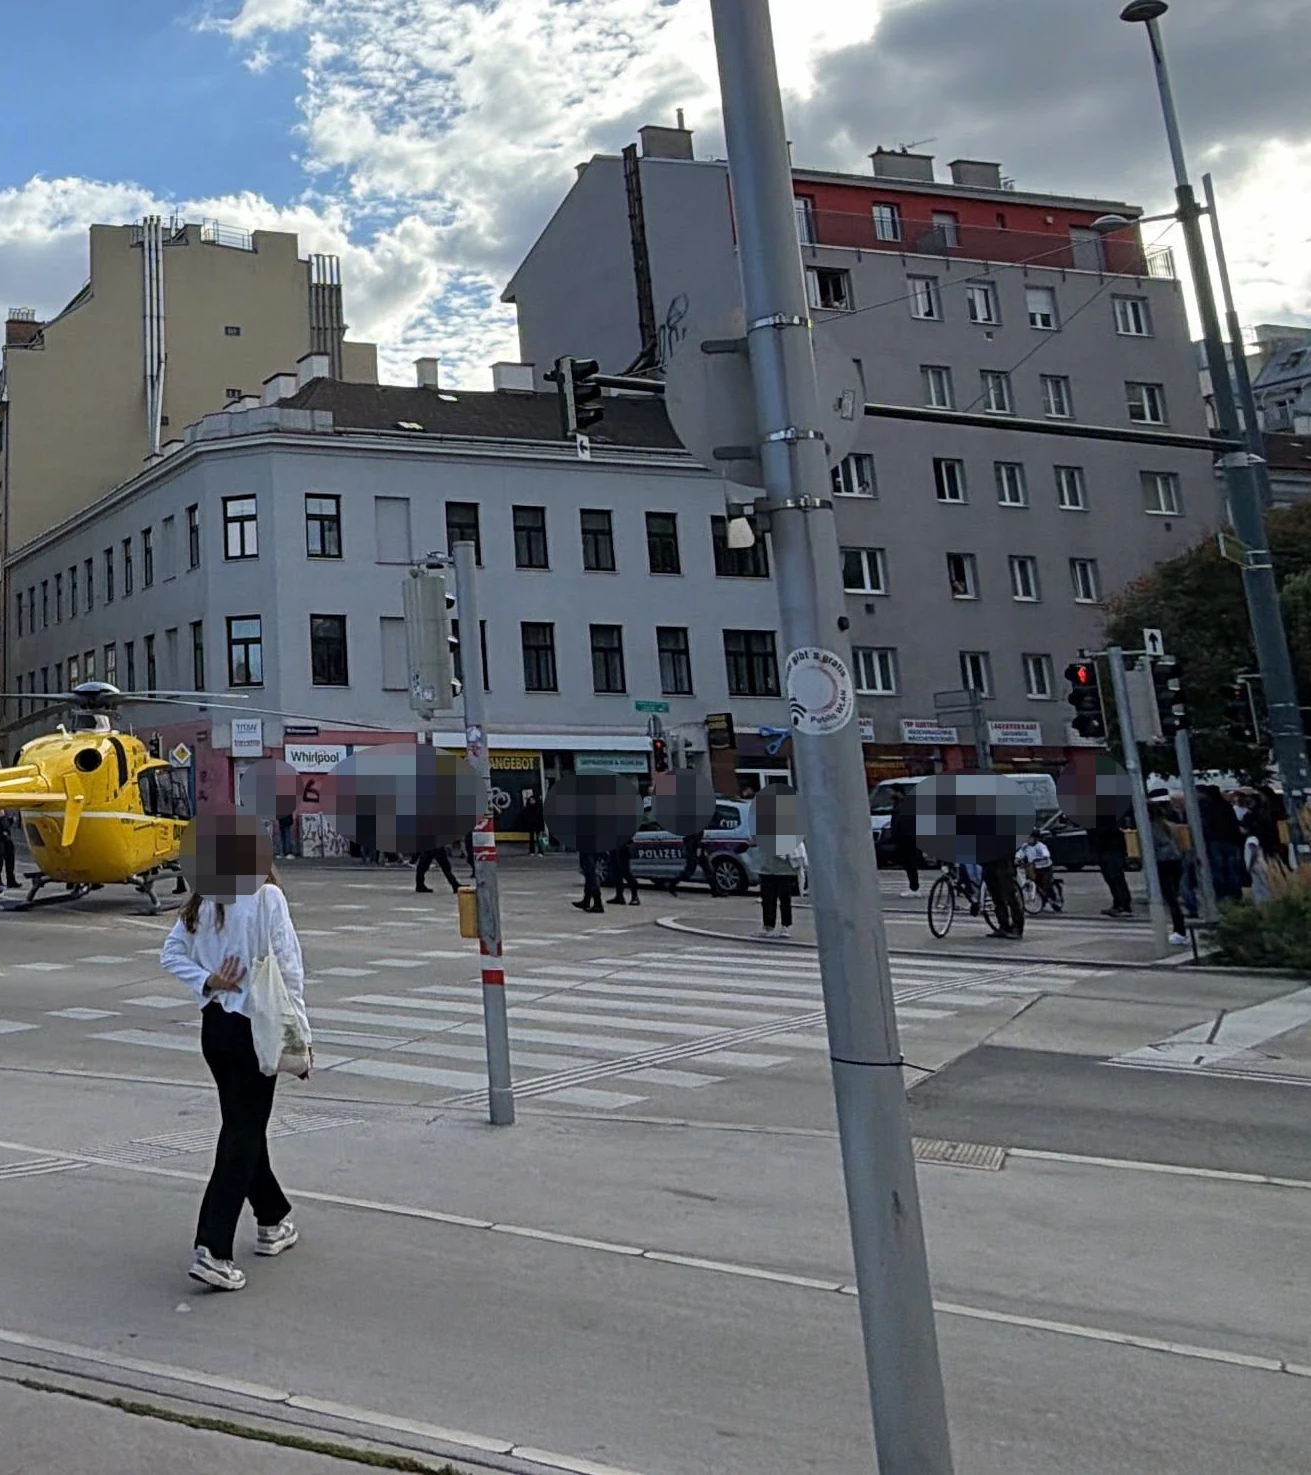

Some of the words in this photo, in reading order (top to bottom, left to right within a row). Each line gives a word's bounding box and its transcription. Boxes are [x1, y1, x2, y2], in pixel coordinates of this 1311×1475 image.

[822, 655, 846, 677] gratis
[290, 751, 340, 765] Whirlpool
[490, 756, 534, 770] ANGEBOT
[638, 849, 682, 859] POLIZEI
